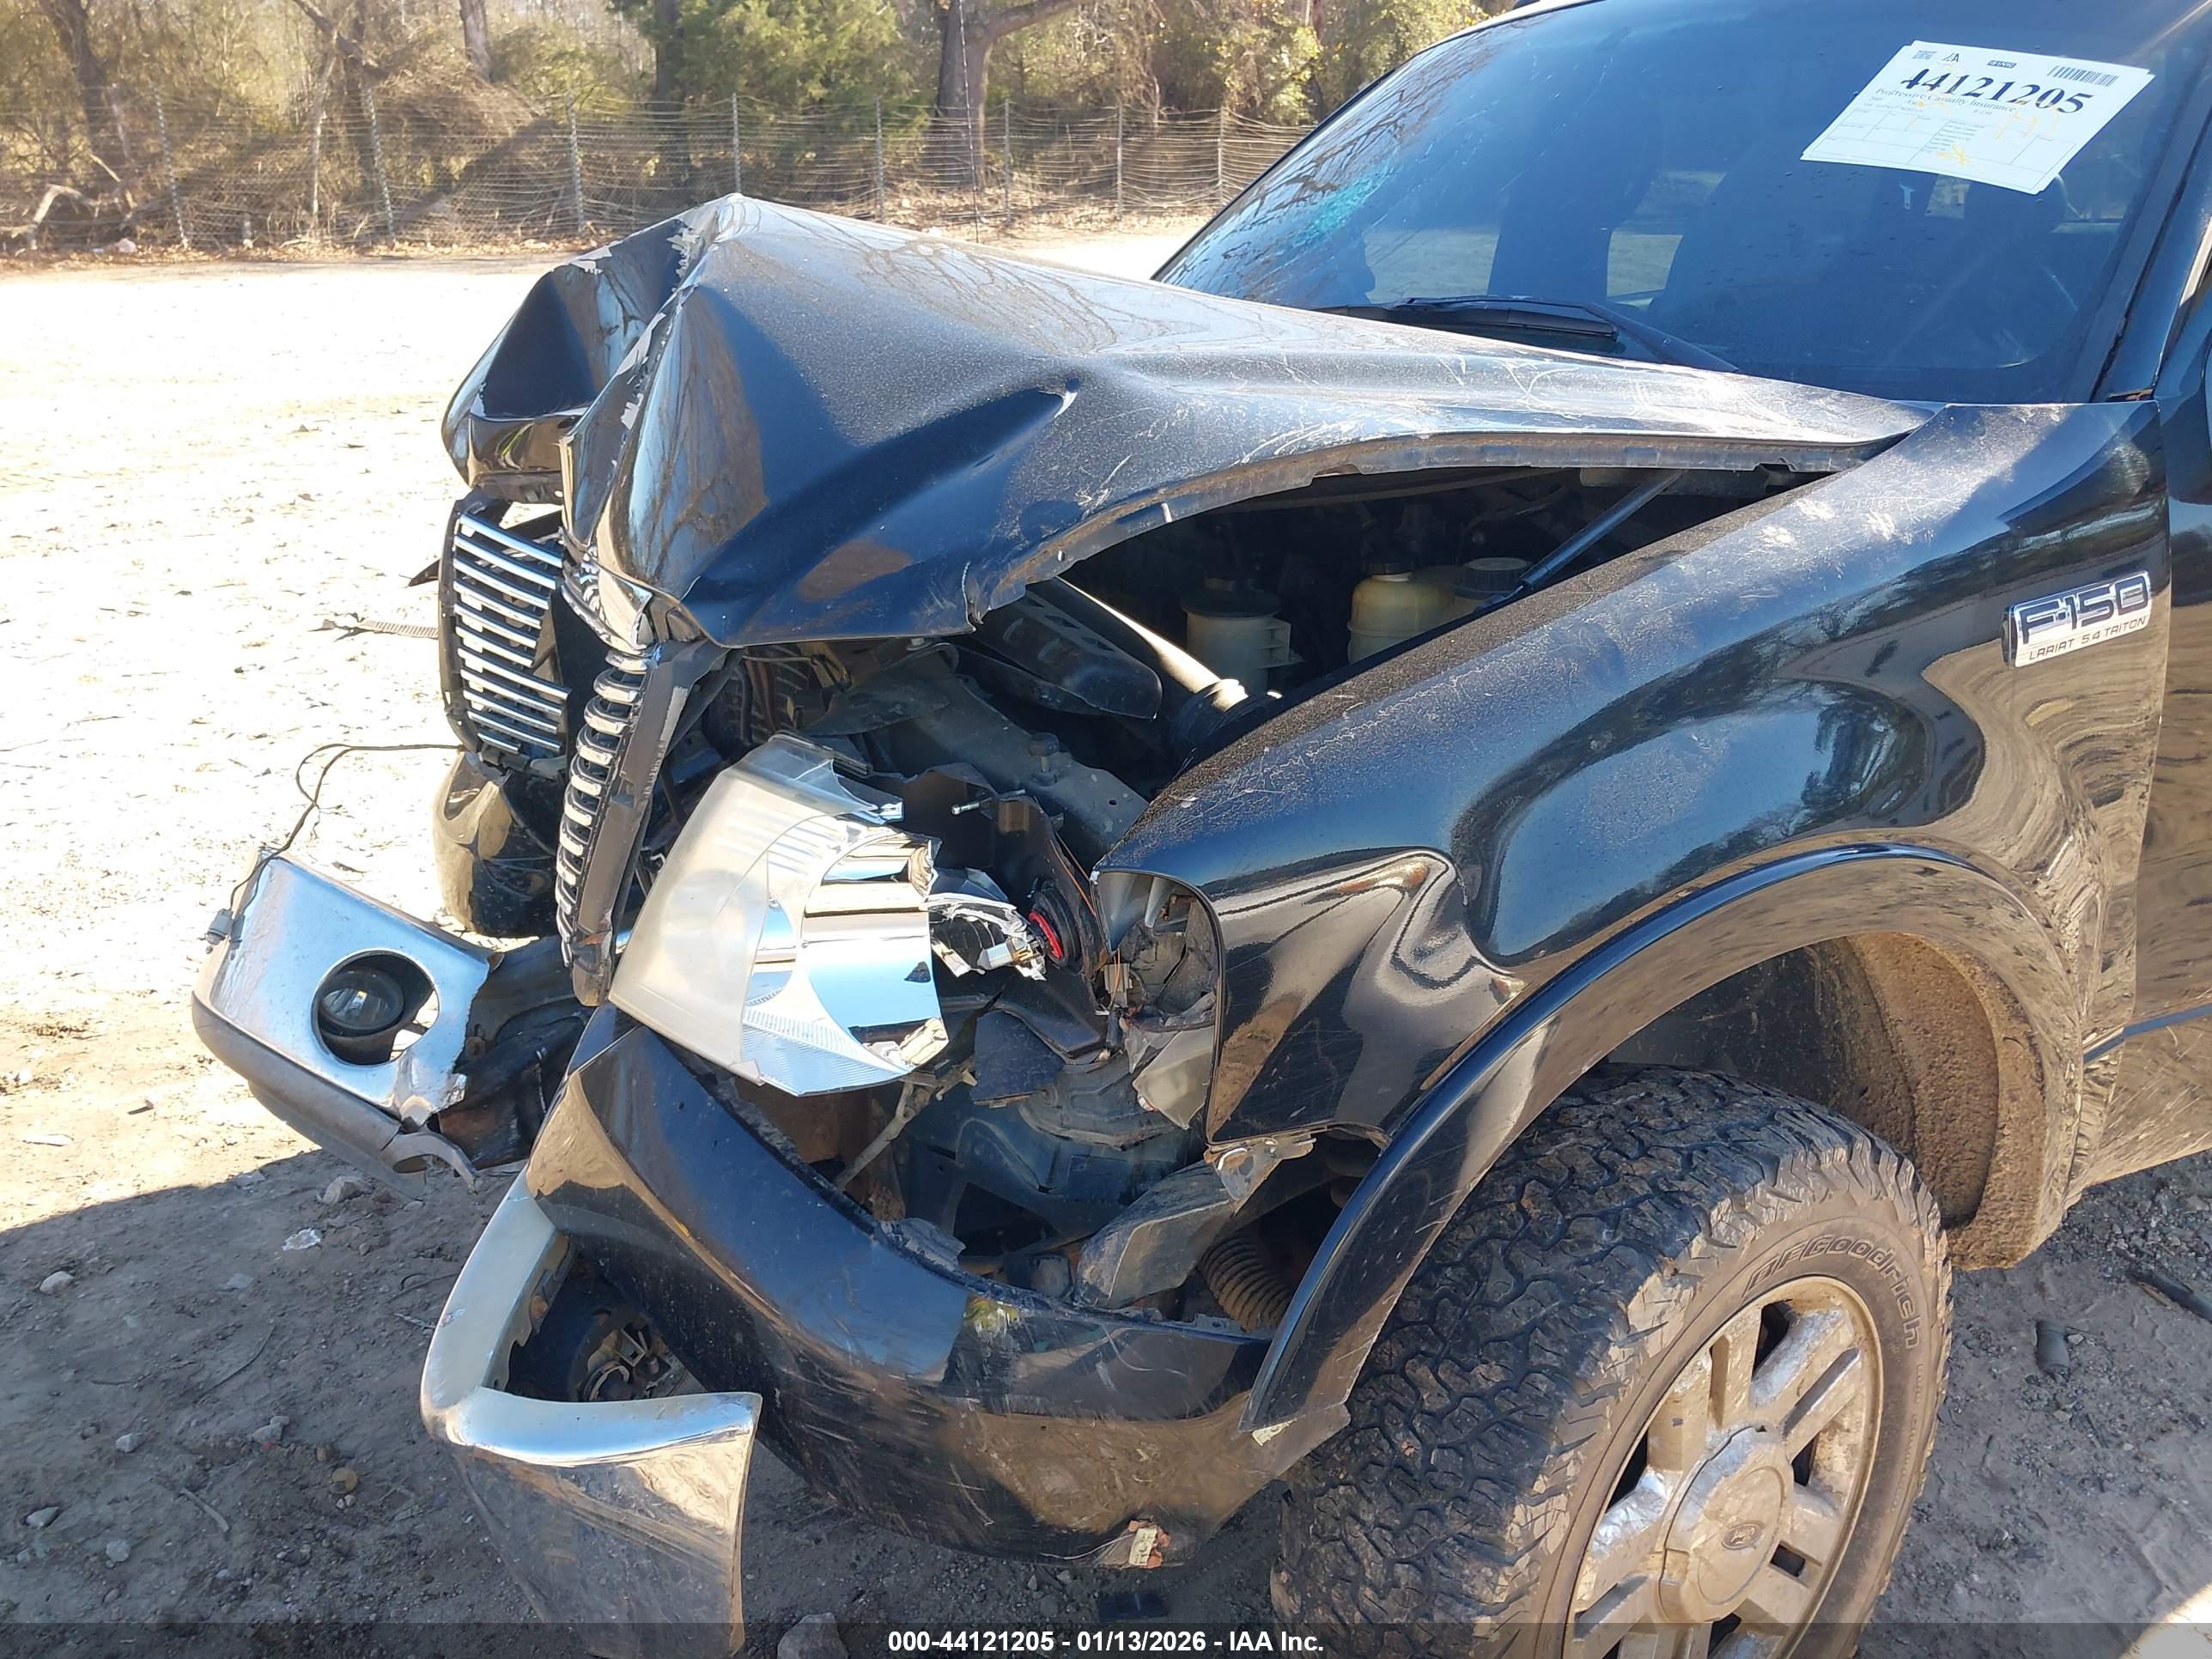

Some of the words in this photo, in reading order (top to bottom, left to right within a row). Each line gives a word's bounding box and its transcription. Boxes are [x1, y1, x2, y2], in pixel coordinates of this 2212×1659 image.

[1875, 88, 1926, 100] Progressive
[1970, 100, 2017, 112] Insurance
[1900, 68, 2094, 113] 44121205
[2019, 574, 2149, 645] F-150
[2029, 638, 2075, 660] LARIAT
[2105, 617, 2147, 637] TRITON
[1741, 1233, 1923, 1349] BFGoodrich
